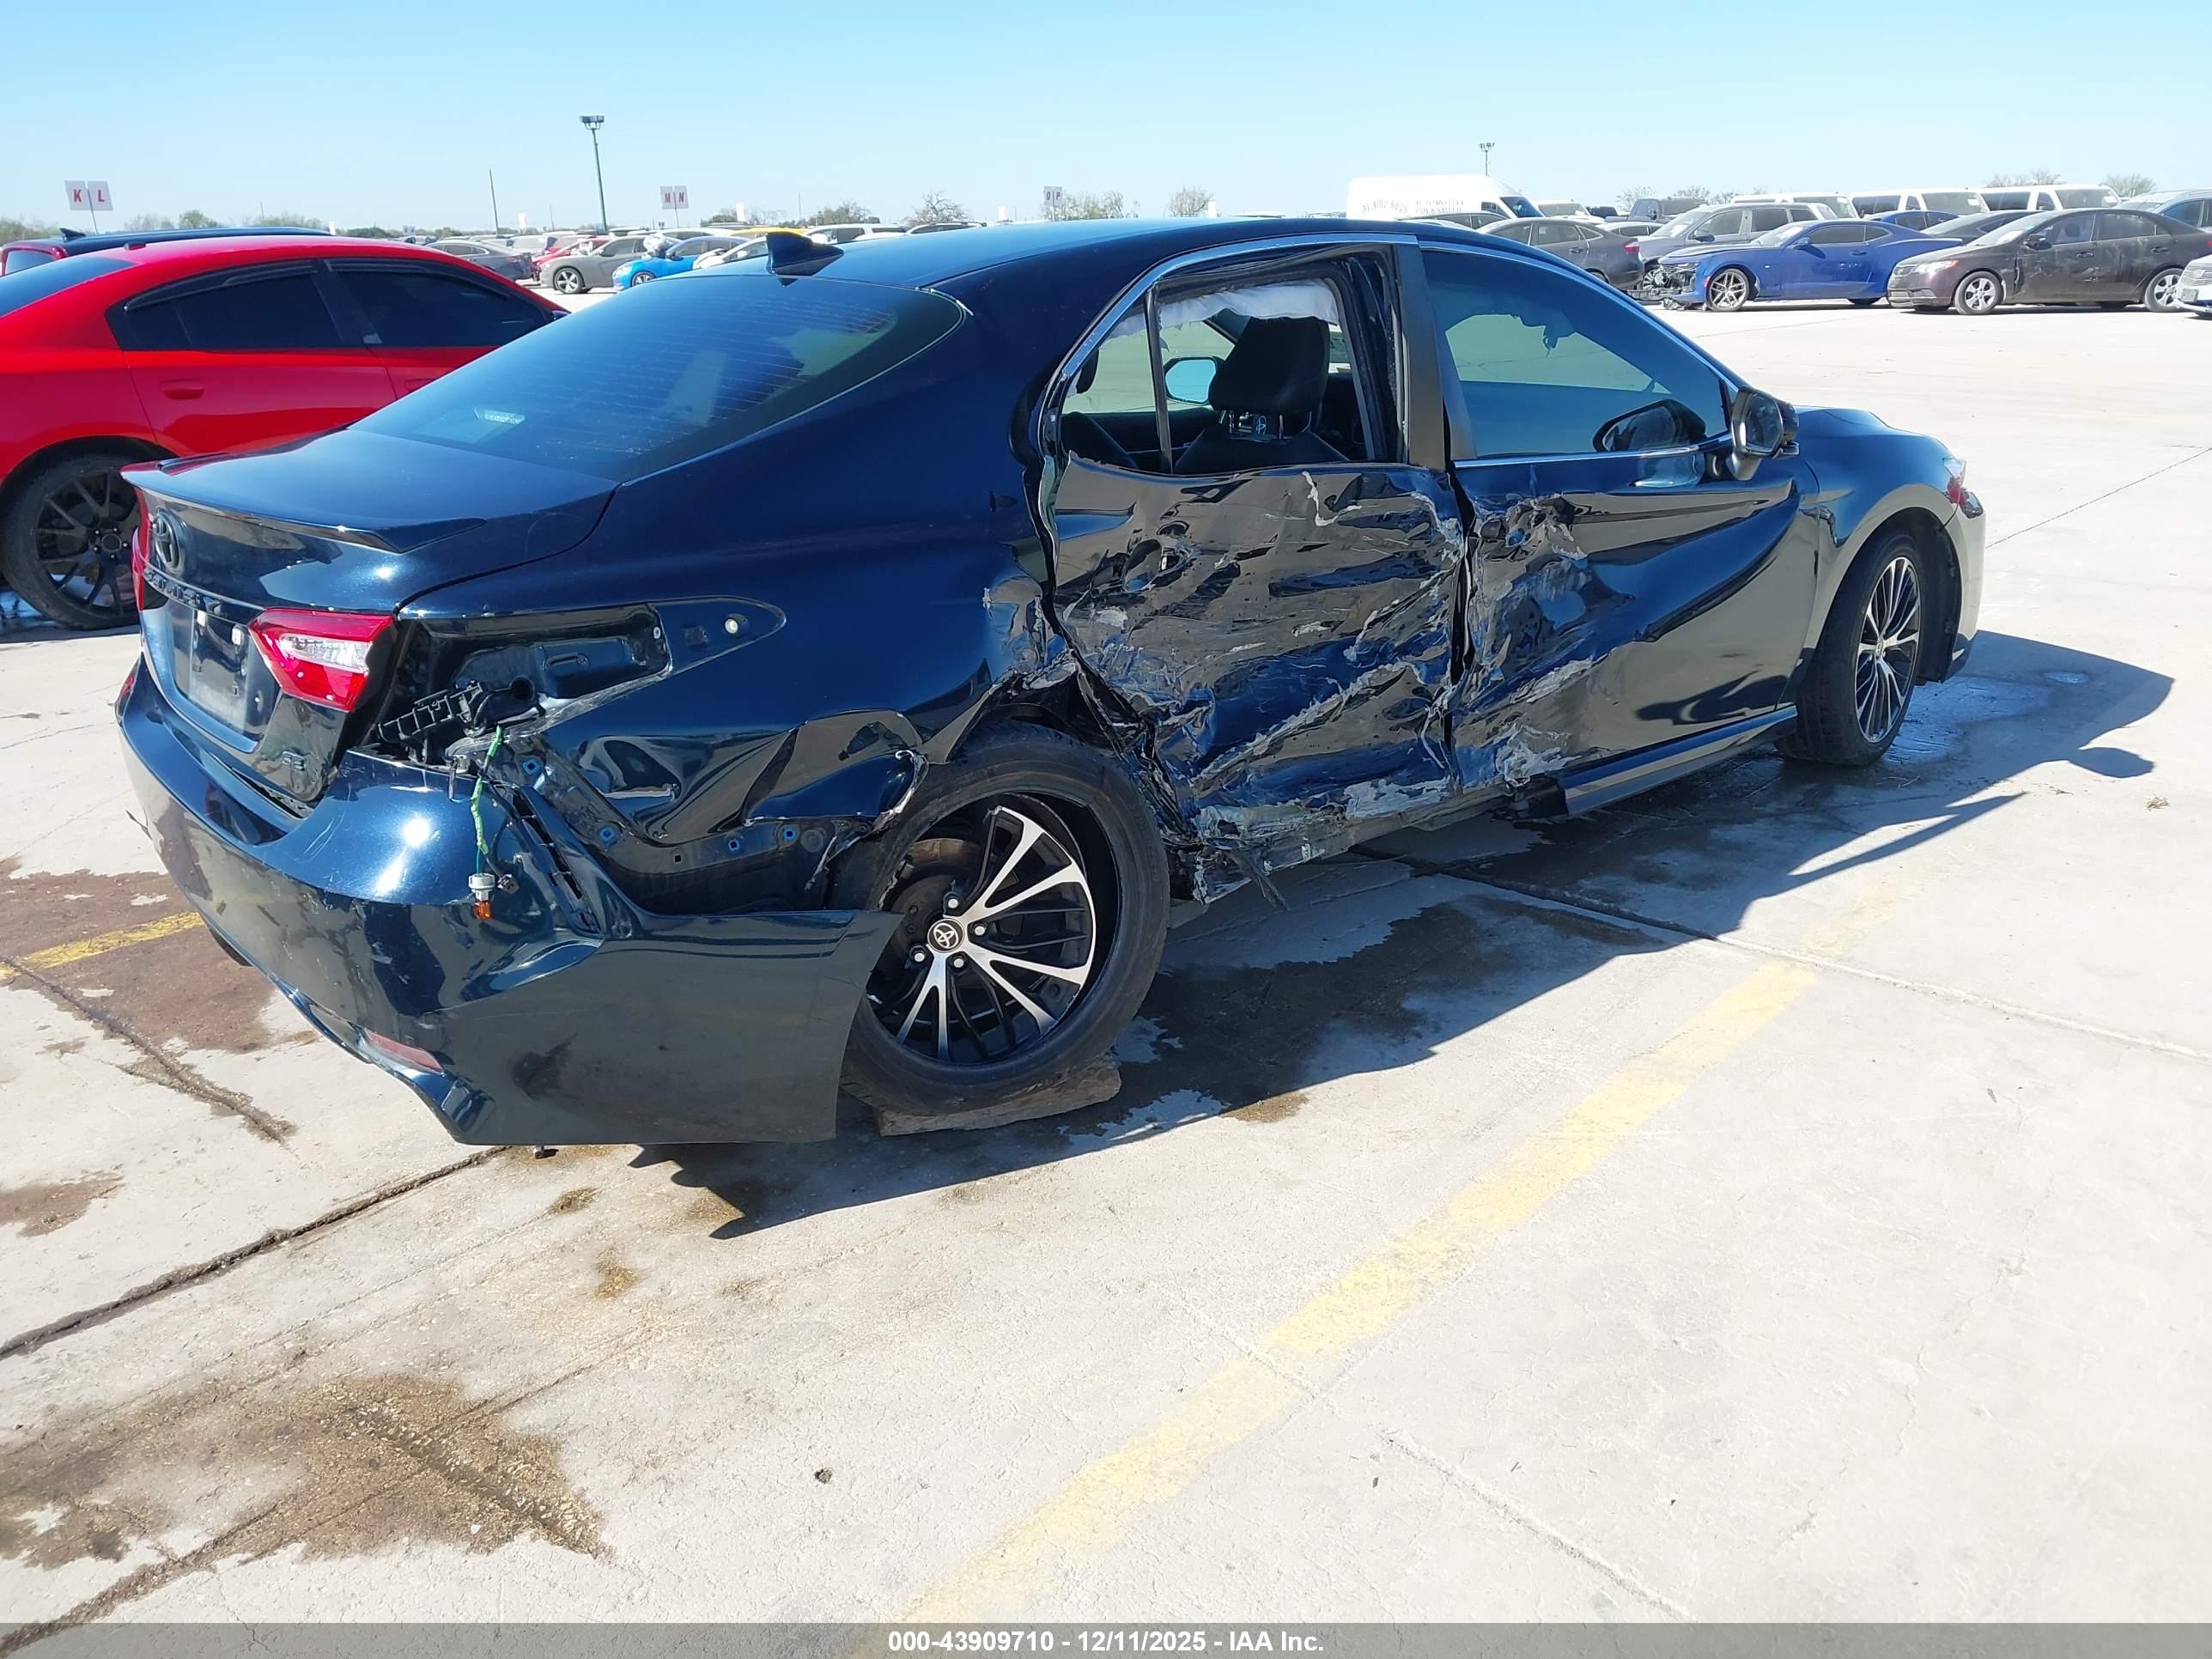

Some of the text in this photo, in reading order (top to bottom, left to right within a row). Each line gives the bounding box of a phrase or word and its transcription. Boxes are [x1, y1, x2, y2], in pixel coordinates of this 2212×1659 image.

[73, 189, 106, 203] K L
[665, 191, 684, 204] M N
[1056, 191, 1060, 200] P
